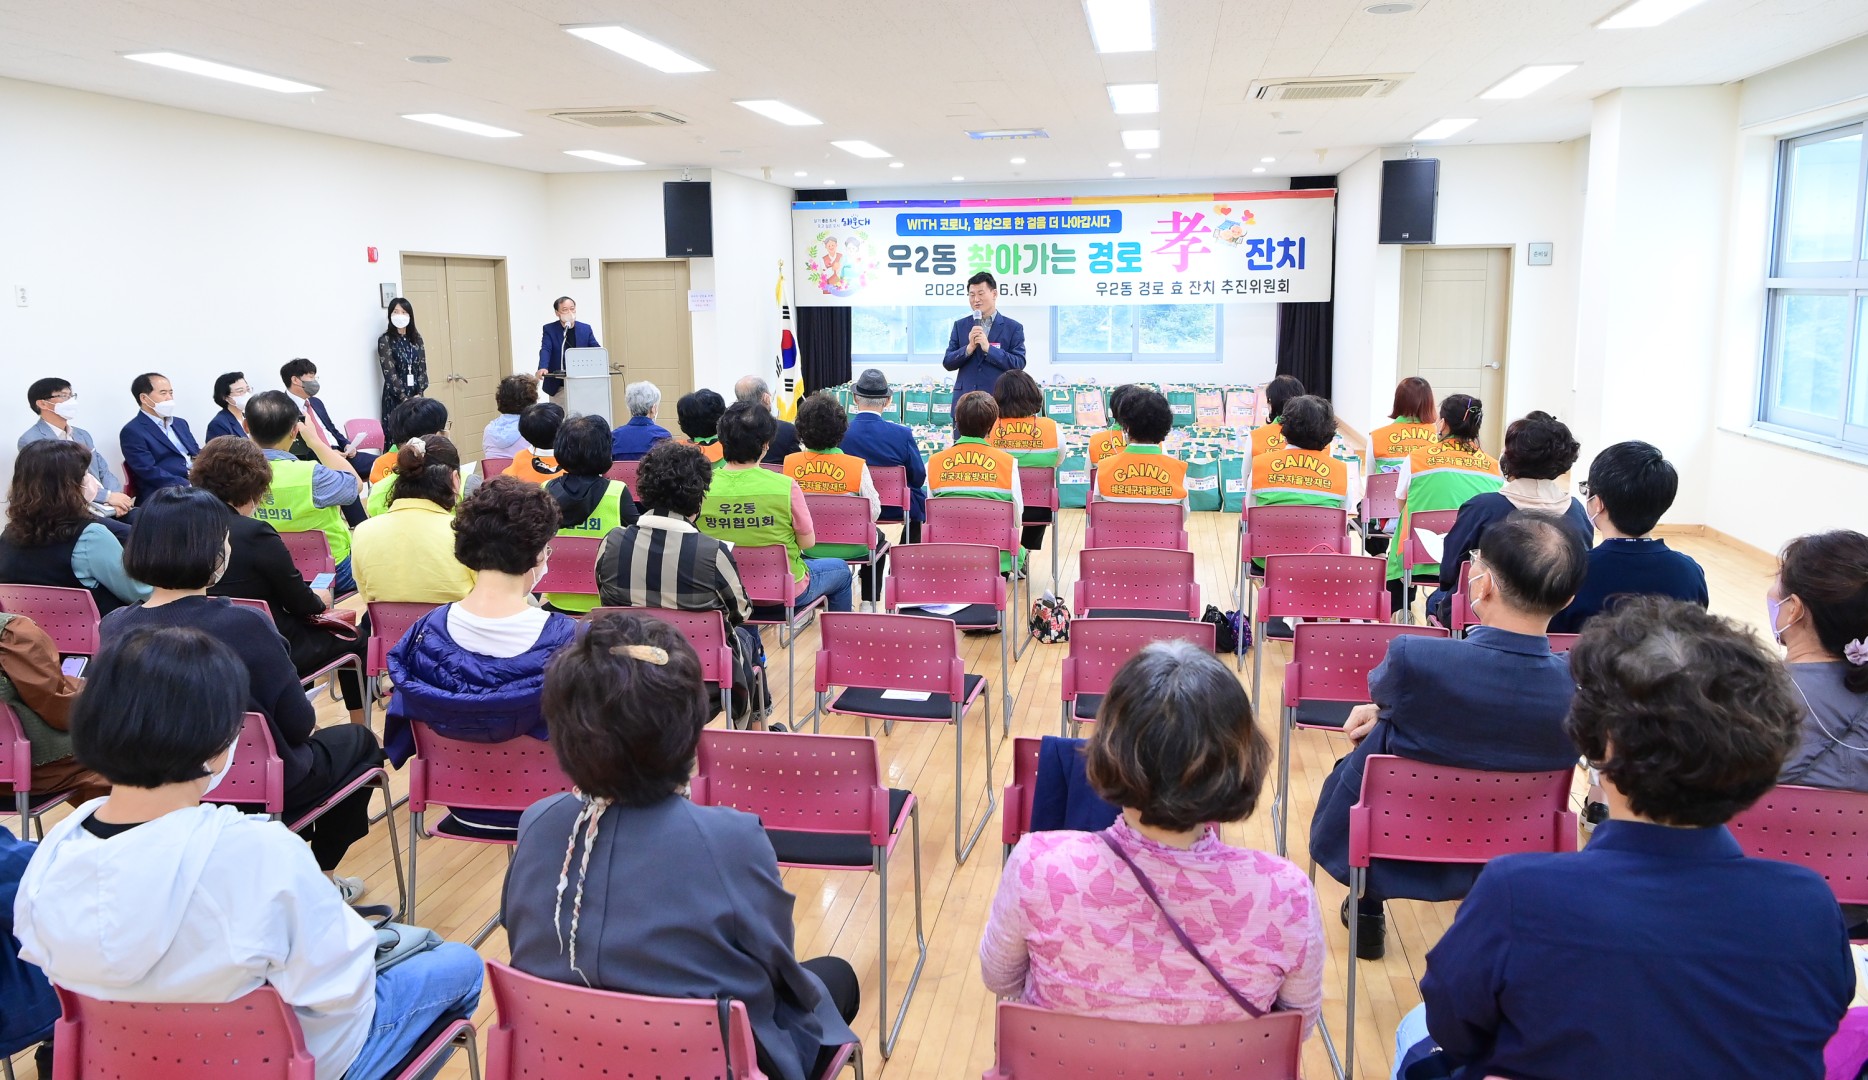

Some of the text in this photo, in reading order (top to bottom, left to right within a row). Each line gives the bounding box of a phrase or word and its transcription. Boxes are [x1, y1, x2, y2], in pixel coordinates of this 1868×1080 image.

[906, 214, 1112, 232] WITH 코로나, 일상으로 한 걸음 더 나아갑시다
[1150, 210, 1212, 273] 孝
[887, 241, 1143, 276] 우2동 찾아가는 경로
[1245, 236, 1306, 271] 잔치
[1096, 277, 1290, 297] 우2동 경로 효 잔치 추진위원회
[994, 422, 1042, 439] CAIND
[1388, 427, 1439, 445] CAIND
[942, 451, 997, 471] CAIND
[1270, 454, 1331, 477] CAIND
[1426, 455, 1491, 470] 전국자율방재단
[794, 461, 846, 481] CAIND
[940, 471, 998, 483] 전국자율방재단
[1113, 462, 1171, 484] CAIND
[798, 479, 847, 492] 국자율방재단
[1110, 484, 1173, 496] 해운대구자율방재단
[1267, 473, 1332, 489] 전국자율방재단
[719, 502, 756, 515] 우2동
[705, 515, 775, 529] 방위협의회
